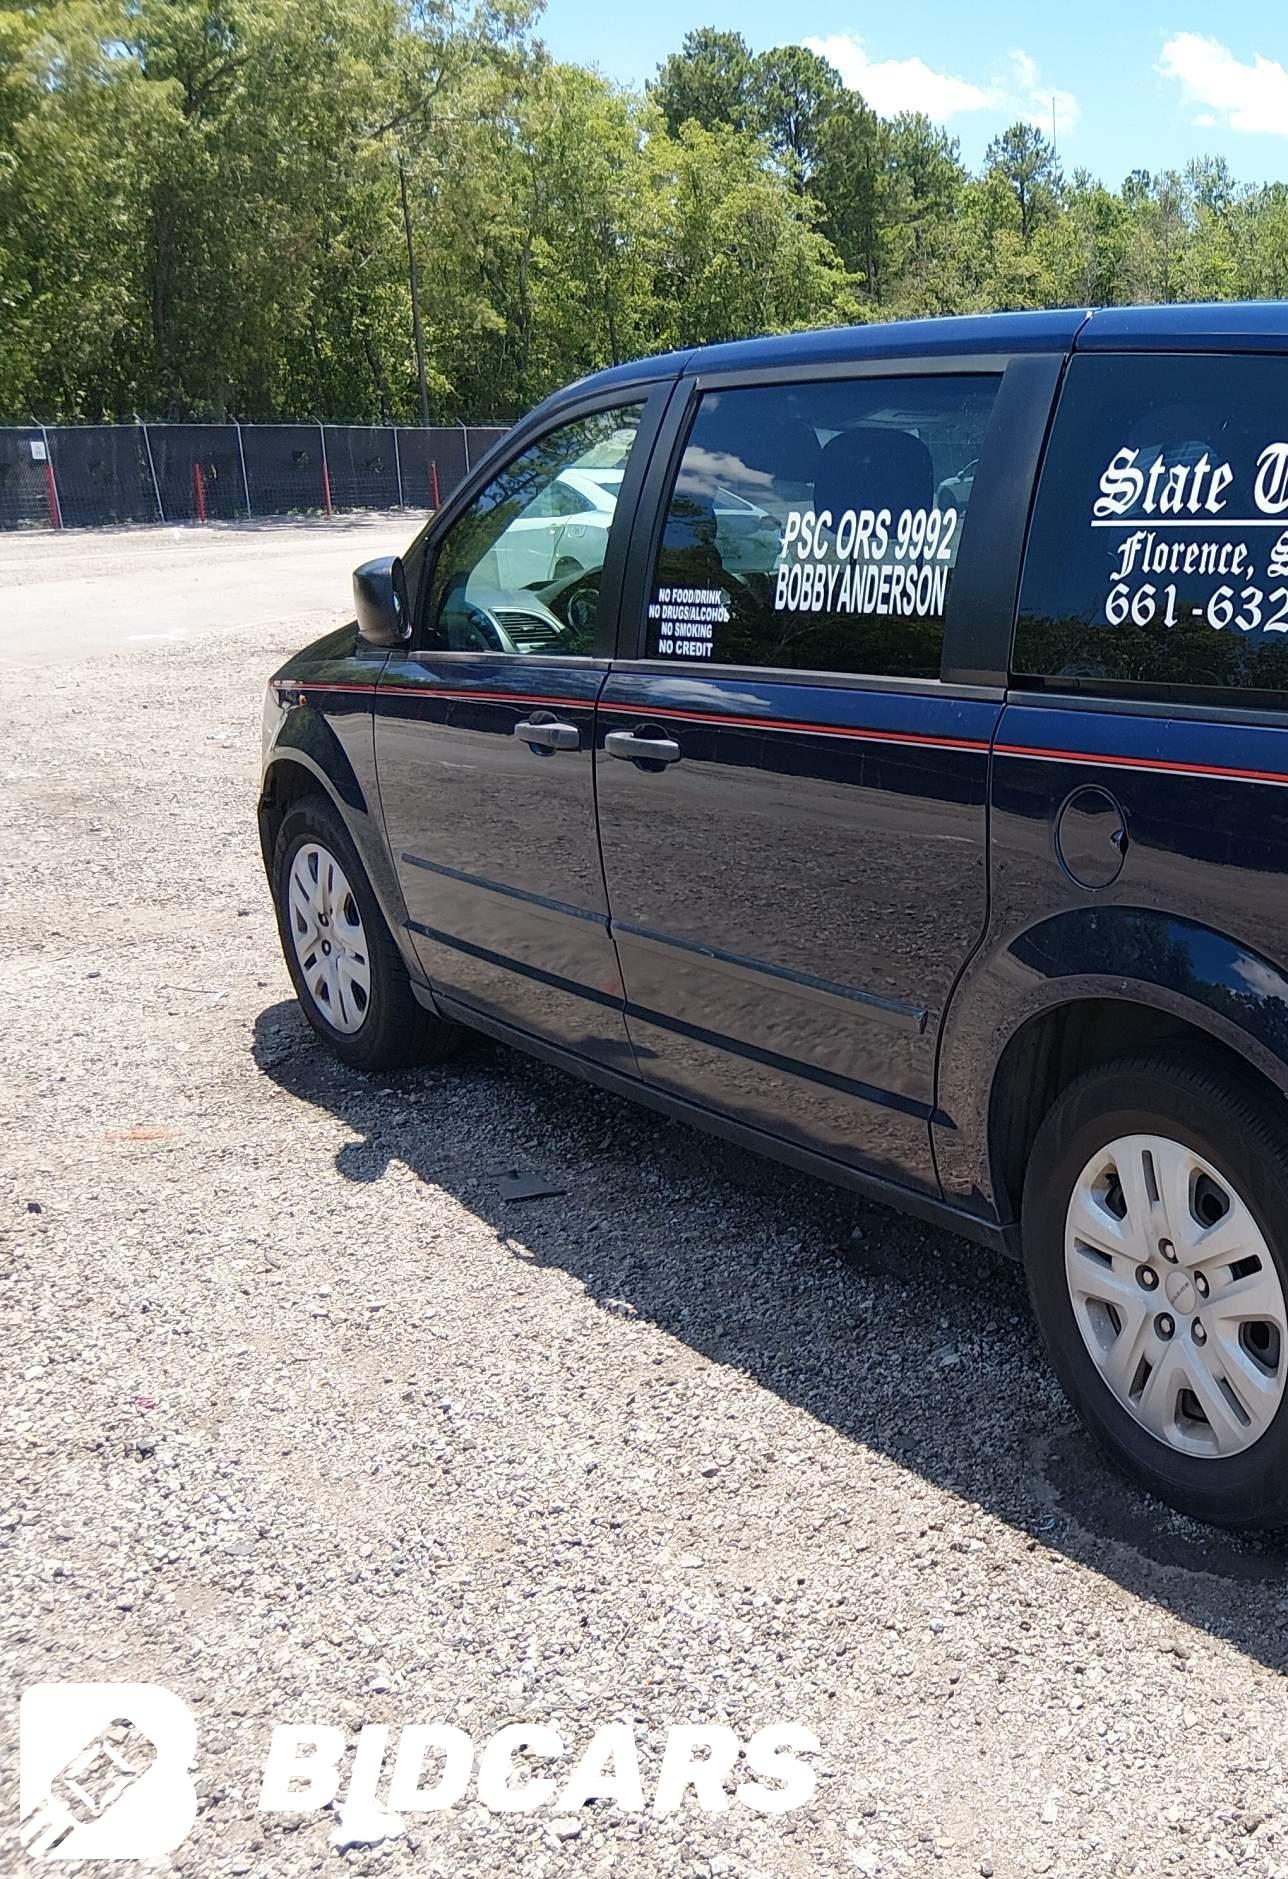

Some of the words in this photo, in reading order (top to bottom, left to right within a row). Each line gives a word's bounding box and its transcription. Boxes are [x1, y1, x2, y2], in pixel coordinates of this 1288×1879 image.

[1093, 447, 1234, 517] State
[781, 509, 833, 560] PSC
[836, 508, 892, 560] ORS
[894, 507, 958, 560] 9992
[1109, 530, 1255, 581] Florence,
[658, 588, 671, 602] NO
[672, 588, 722, 605] FOOD/DRINK
[774, 563, 840, 613] BOBBY
[836, 564, 949, 617] ANDERSON
[648, 604, 661, 619] NO
[661, 621, 673, 636] NO
[674, 622, 713, 639] SMOKING
[658, 639, 674, 654] NO
[675, 640, 714, 657] CREDIT
